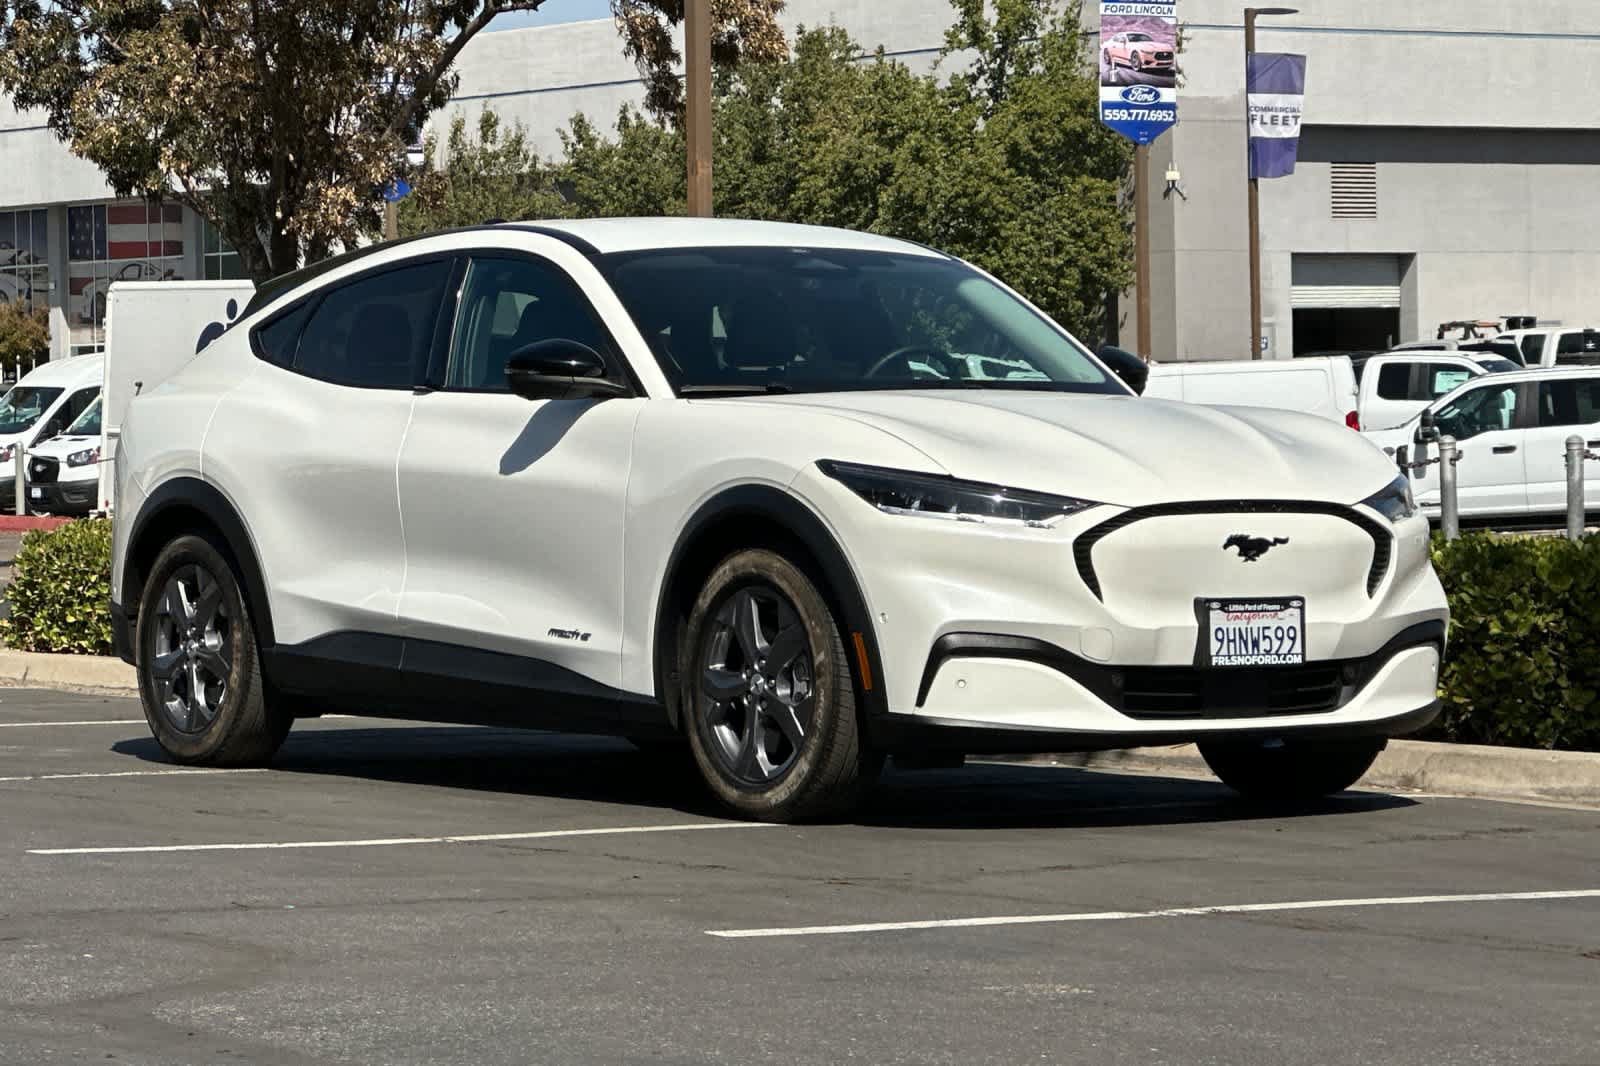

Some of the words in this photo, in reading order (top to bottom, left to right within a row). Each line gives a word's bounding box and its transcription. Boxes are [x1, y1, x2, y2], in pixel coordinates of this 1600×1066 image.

[1103, 4, 1133, 14] FORD
[1134, 5, 1174, 15] LINCOLN
[1128, 87, 1156, 102] Ford
[1103, 109, 1175, 122] 559.777.6952
[1250, 114, 1301, 126] FLEET
[1214, 625, 1297, 656] 9HNW599
[1211, 654, 1303, 666] FRESNOFORD.COM
